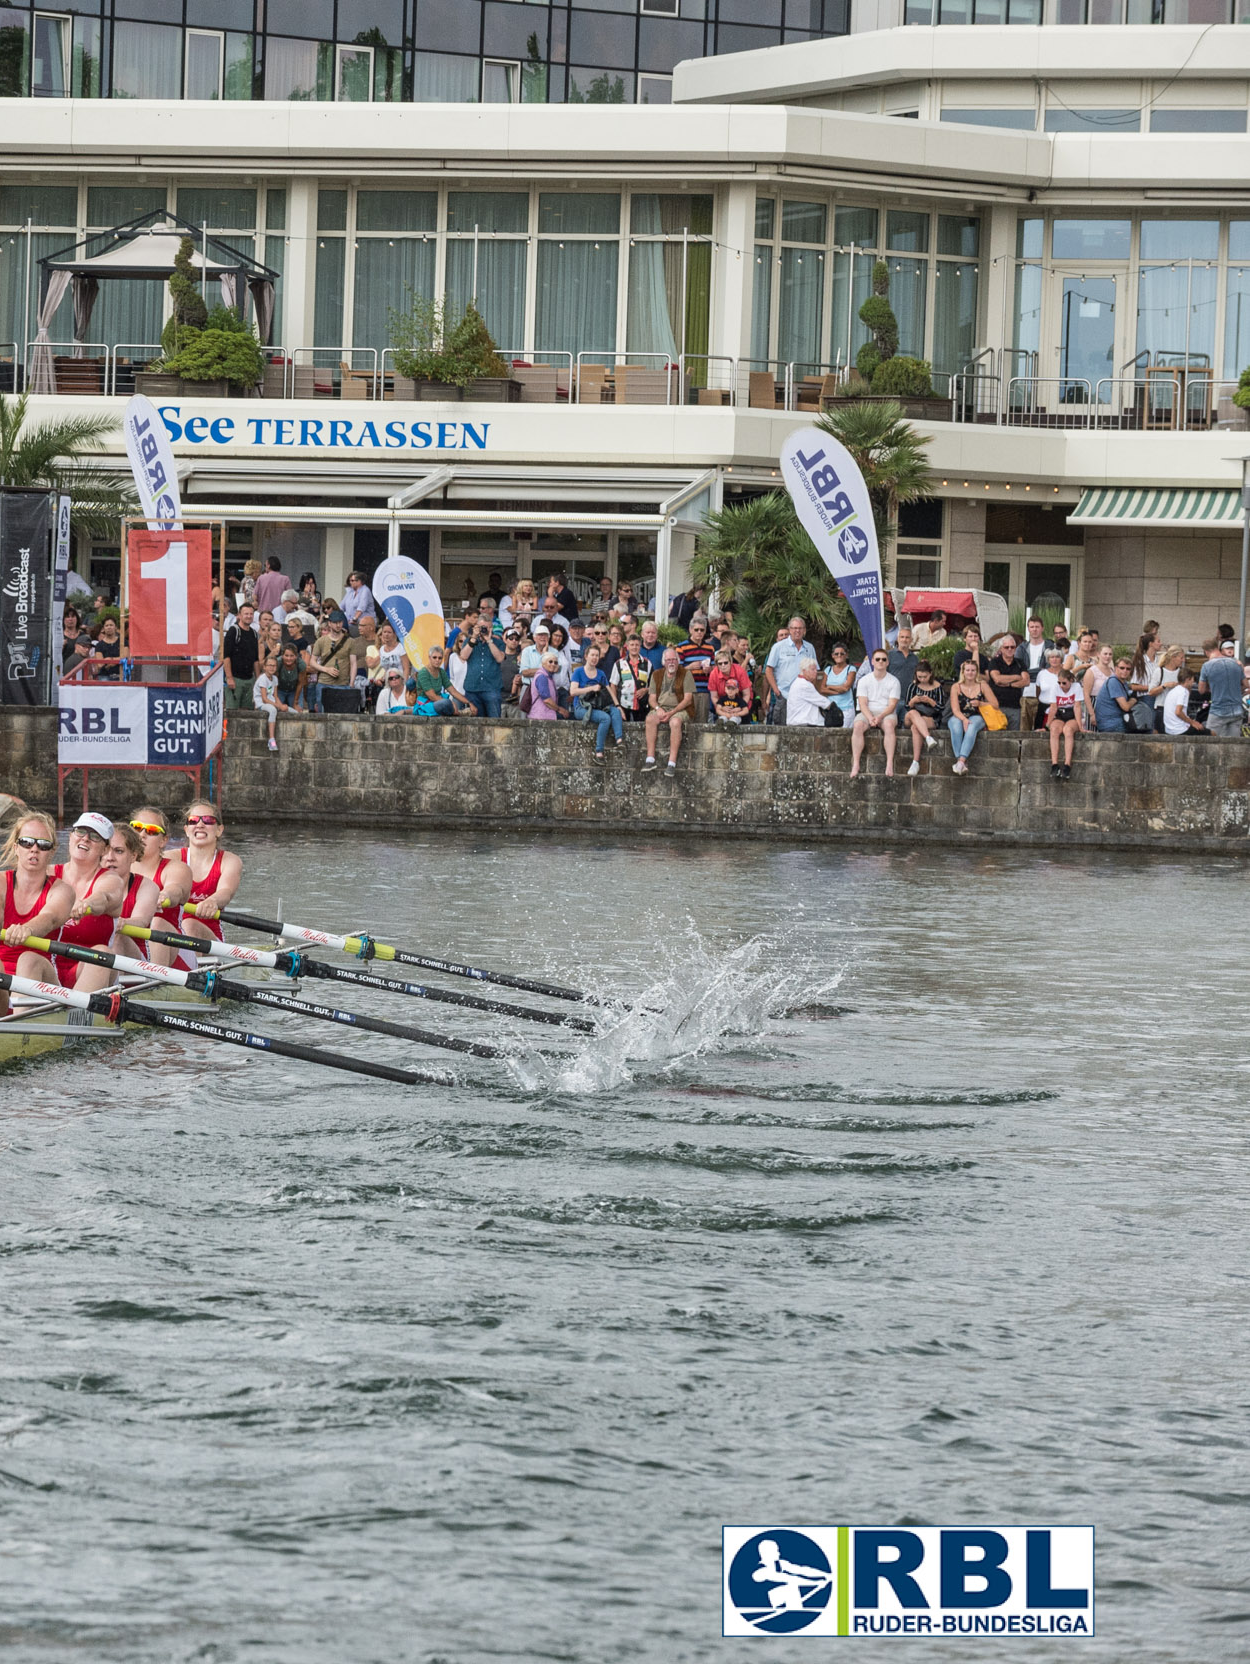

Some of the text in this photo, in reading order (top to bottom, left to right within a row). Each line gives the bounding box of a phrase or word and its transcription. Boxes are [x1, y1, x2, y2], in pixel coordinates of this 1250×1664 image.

[158, 406, 491, 449] See TERRASSEN
[15, 547, 30, 613] Broadcast
[141, 541, 188, 644] 1
[15, 615, 28, 639] Live
[58, 708, 131, 734] RBL
[154, 738, 194, 754] GUT.
[301, 927, 329, 945] Melitta
[229, 945, 260, 963] Melitta
[136, 961, 169, 977] Melitta
[337, 969, 357, 980] STARK.
[358, 974, 388, 988] SCHNELL.
[33, 981, 71, 1000] Melitta
[256, 991, 280, 1004] STARK.
[280, 997, 313, 1012] SCHNELL.
[163, 1015, 266, 1046] STARK. SCHNELL. GUT. RBL
